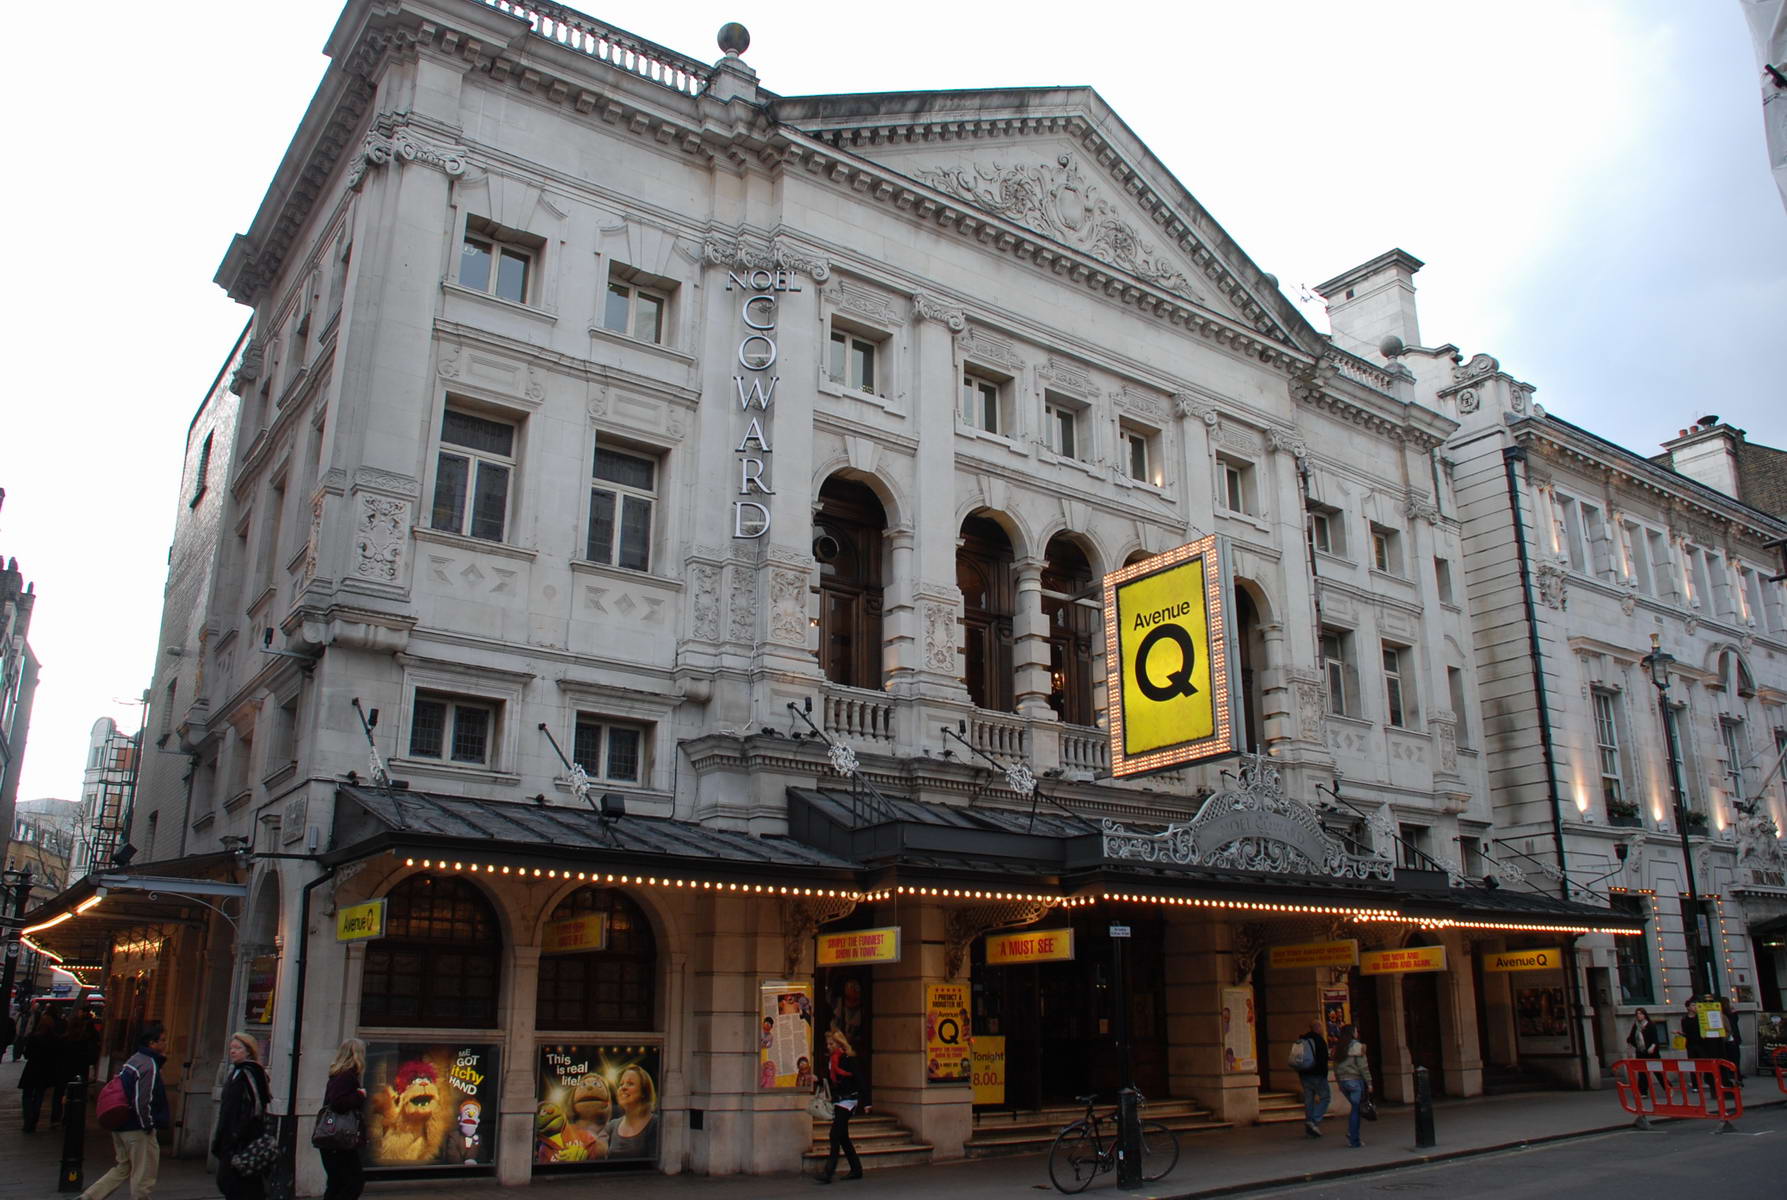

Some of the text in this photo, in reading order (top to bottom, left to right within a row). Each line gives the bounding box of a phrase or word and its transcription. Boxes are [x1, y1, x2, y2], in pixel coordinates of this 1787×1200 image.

[726, 267, 801, 291] NOËL
[732, 295, 780, 539] COWARD
[1133, 601, 1190, 631] Avenue
[1135, 623, 1199, 702] Q
[344, 908, 375, 933] Avenue Q
[1009, 940, 1035, 956] MUST
[1496, 954, 1548, 968] Avenue Q
[938, 1018, 960, 1044] Q
[456, 1055, 480, 1067] GOT
[458, 1048, 471, 1058] ME
[546, 1053, 571, 1066] This
[973, 1051, 1004, 1063] Tonight
[451, 1064, 485, 1086] itchy
[557, 1061, 588, 1075] is real
[449, 1076, 477, 1096] HAND
[562, 1076, 581, 1087] life!
